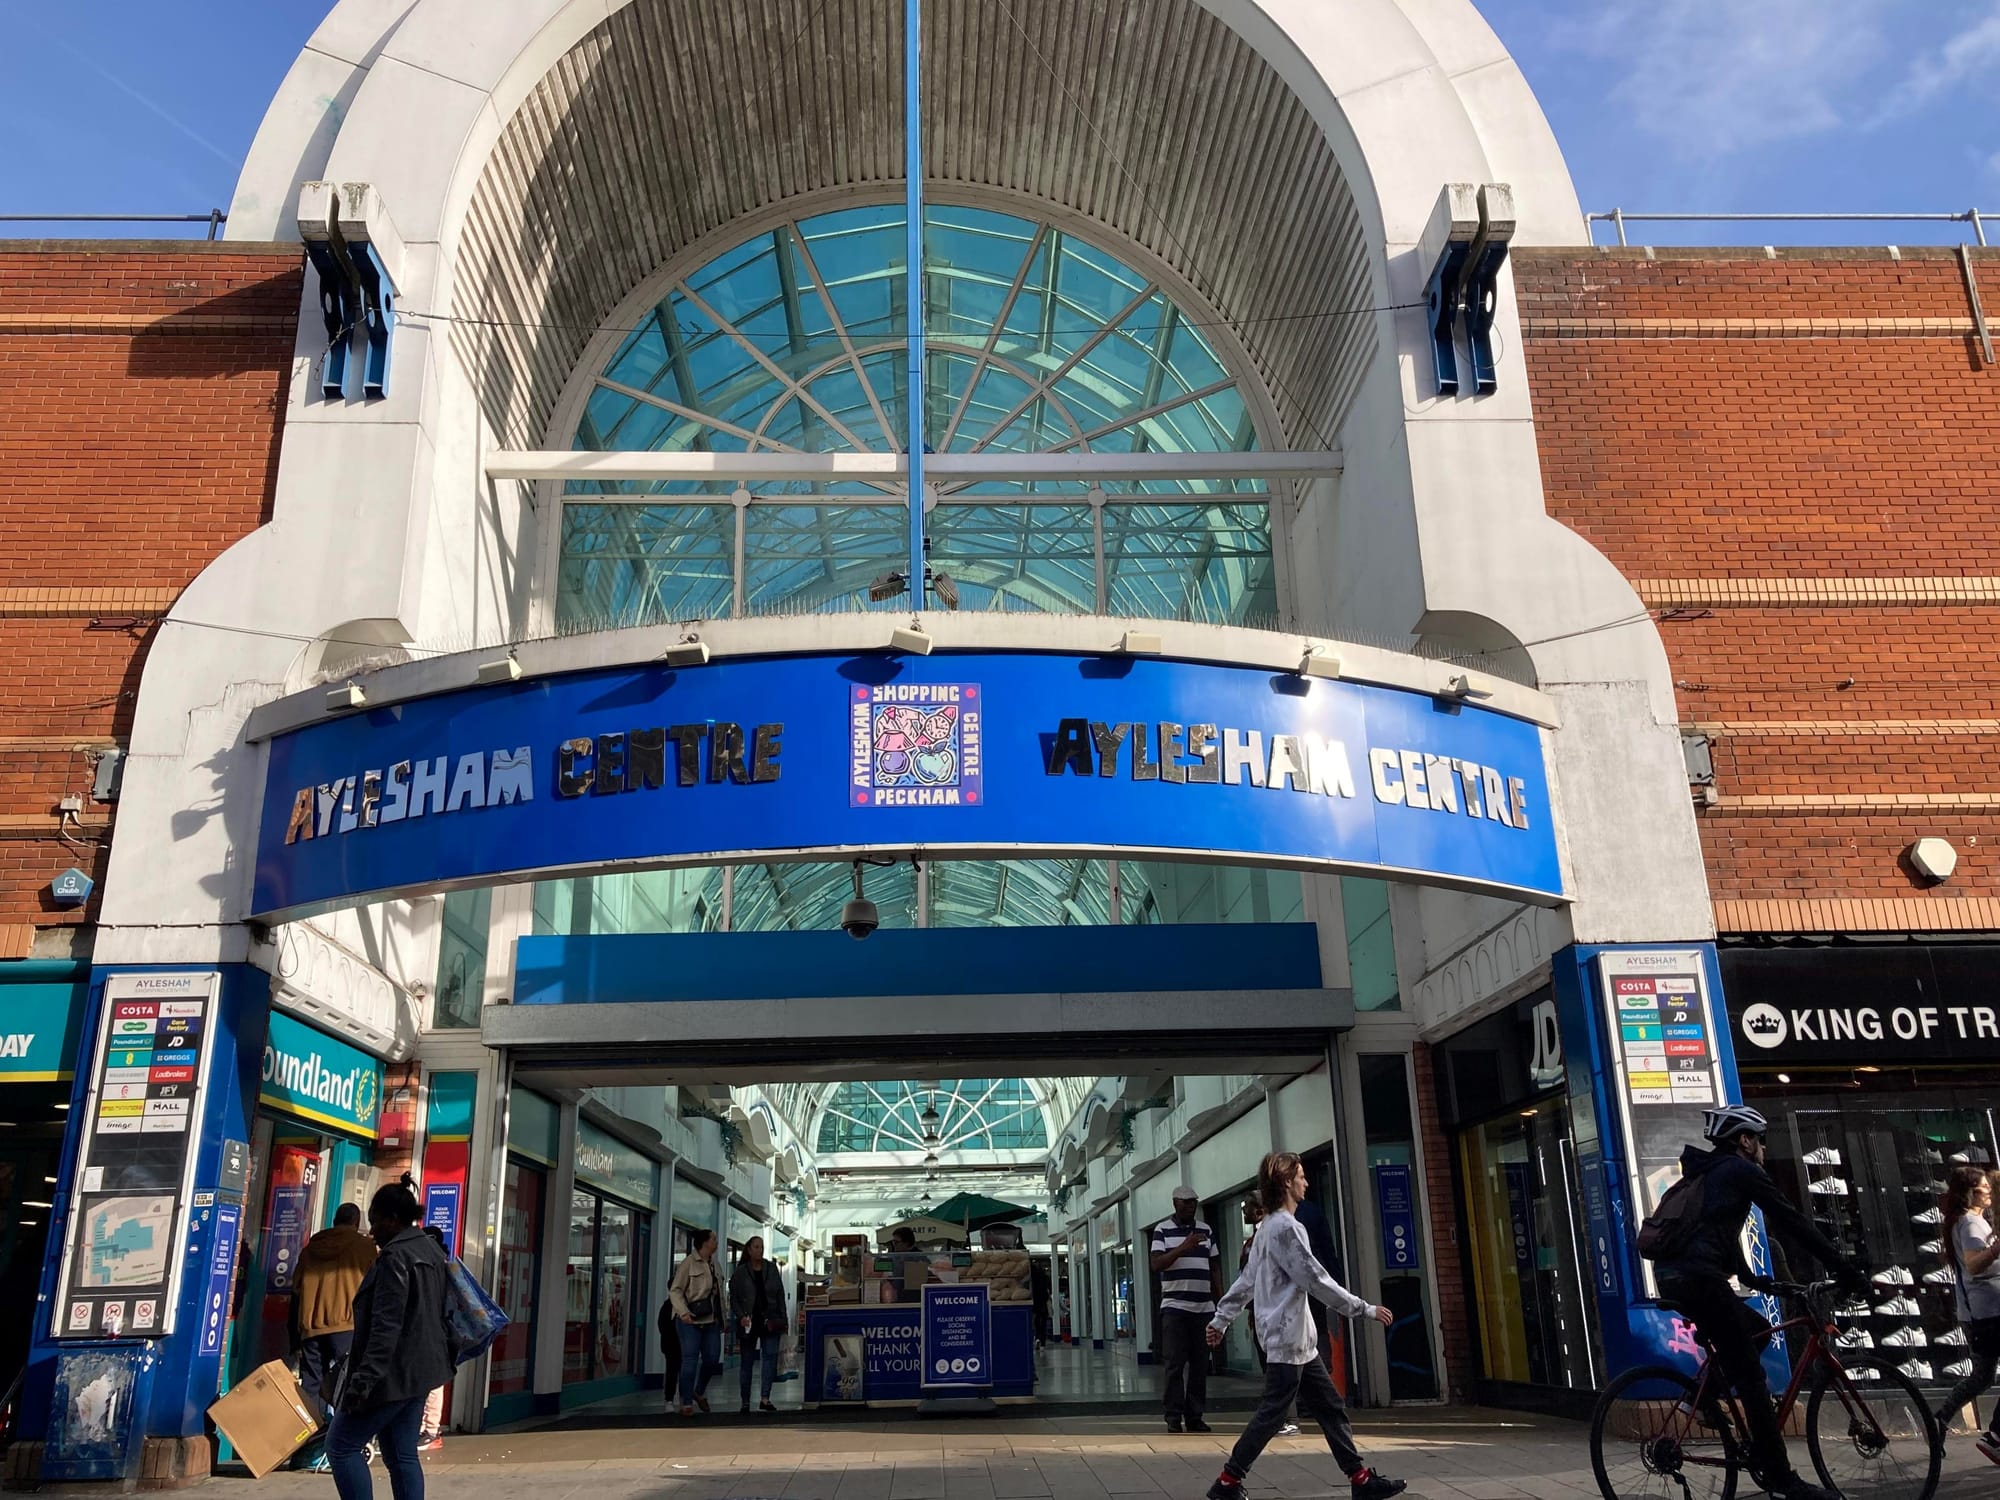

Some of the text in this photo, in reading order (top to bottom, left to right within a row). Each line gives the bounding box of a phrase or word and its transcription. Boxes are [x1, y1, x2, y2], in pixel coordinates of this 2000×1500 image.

[873, 685, 960, 702] SHOPPING
[853, 702, 871, 788] AYLESHAM
[963, 712, 979, 776] CENTRE
[1047, 718, 1528, 829] AYLESHAM CENTRE
[284, 722, 785, 845] AYLESHAM CENTRE
[875, 788, 960, 805] PECKHAM
[57, 887, 80, 895] Chubb
[1626, 956, 1677, 965] AYLESHAM
[135, 979, 191, 988] AYLESHAM
[1620, 982, 1651, 991] COSTA
[121, 1006, 154, 1016] COSTA
[1673, 1011, 1687, 1022] JD
[1791, 1007, 1884, 1041] KING
[1891, 1007, 1940, 1040] OF
[0, 1033, 35, 1058] AY
[168, 1036, 184, 1048] JD
[1530, 1000, 1564, 1088] JD
[1670, 1044, 1700, 1052] Ladbrokes
[1680, 1058, 1695, 1068] JFY
[154, 1070, 188, 1078] Ladbrokes
[262, 1045, 353, 1111] oundland
[160, 1085, 178, 1096] JFY
[152, 1102, 180, 1110] MALL
[575, 1130, 614, 1179] Poundland
[911, 1226, 925, 1234] ART
[934, 1296, 979, 1305] WELCOME
[861, 1325, 922, 1339] WELCOM
[867, 1343, 911, 1355] THANK
[884, 1359, 921, 1372] YOUR
